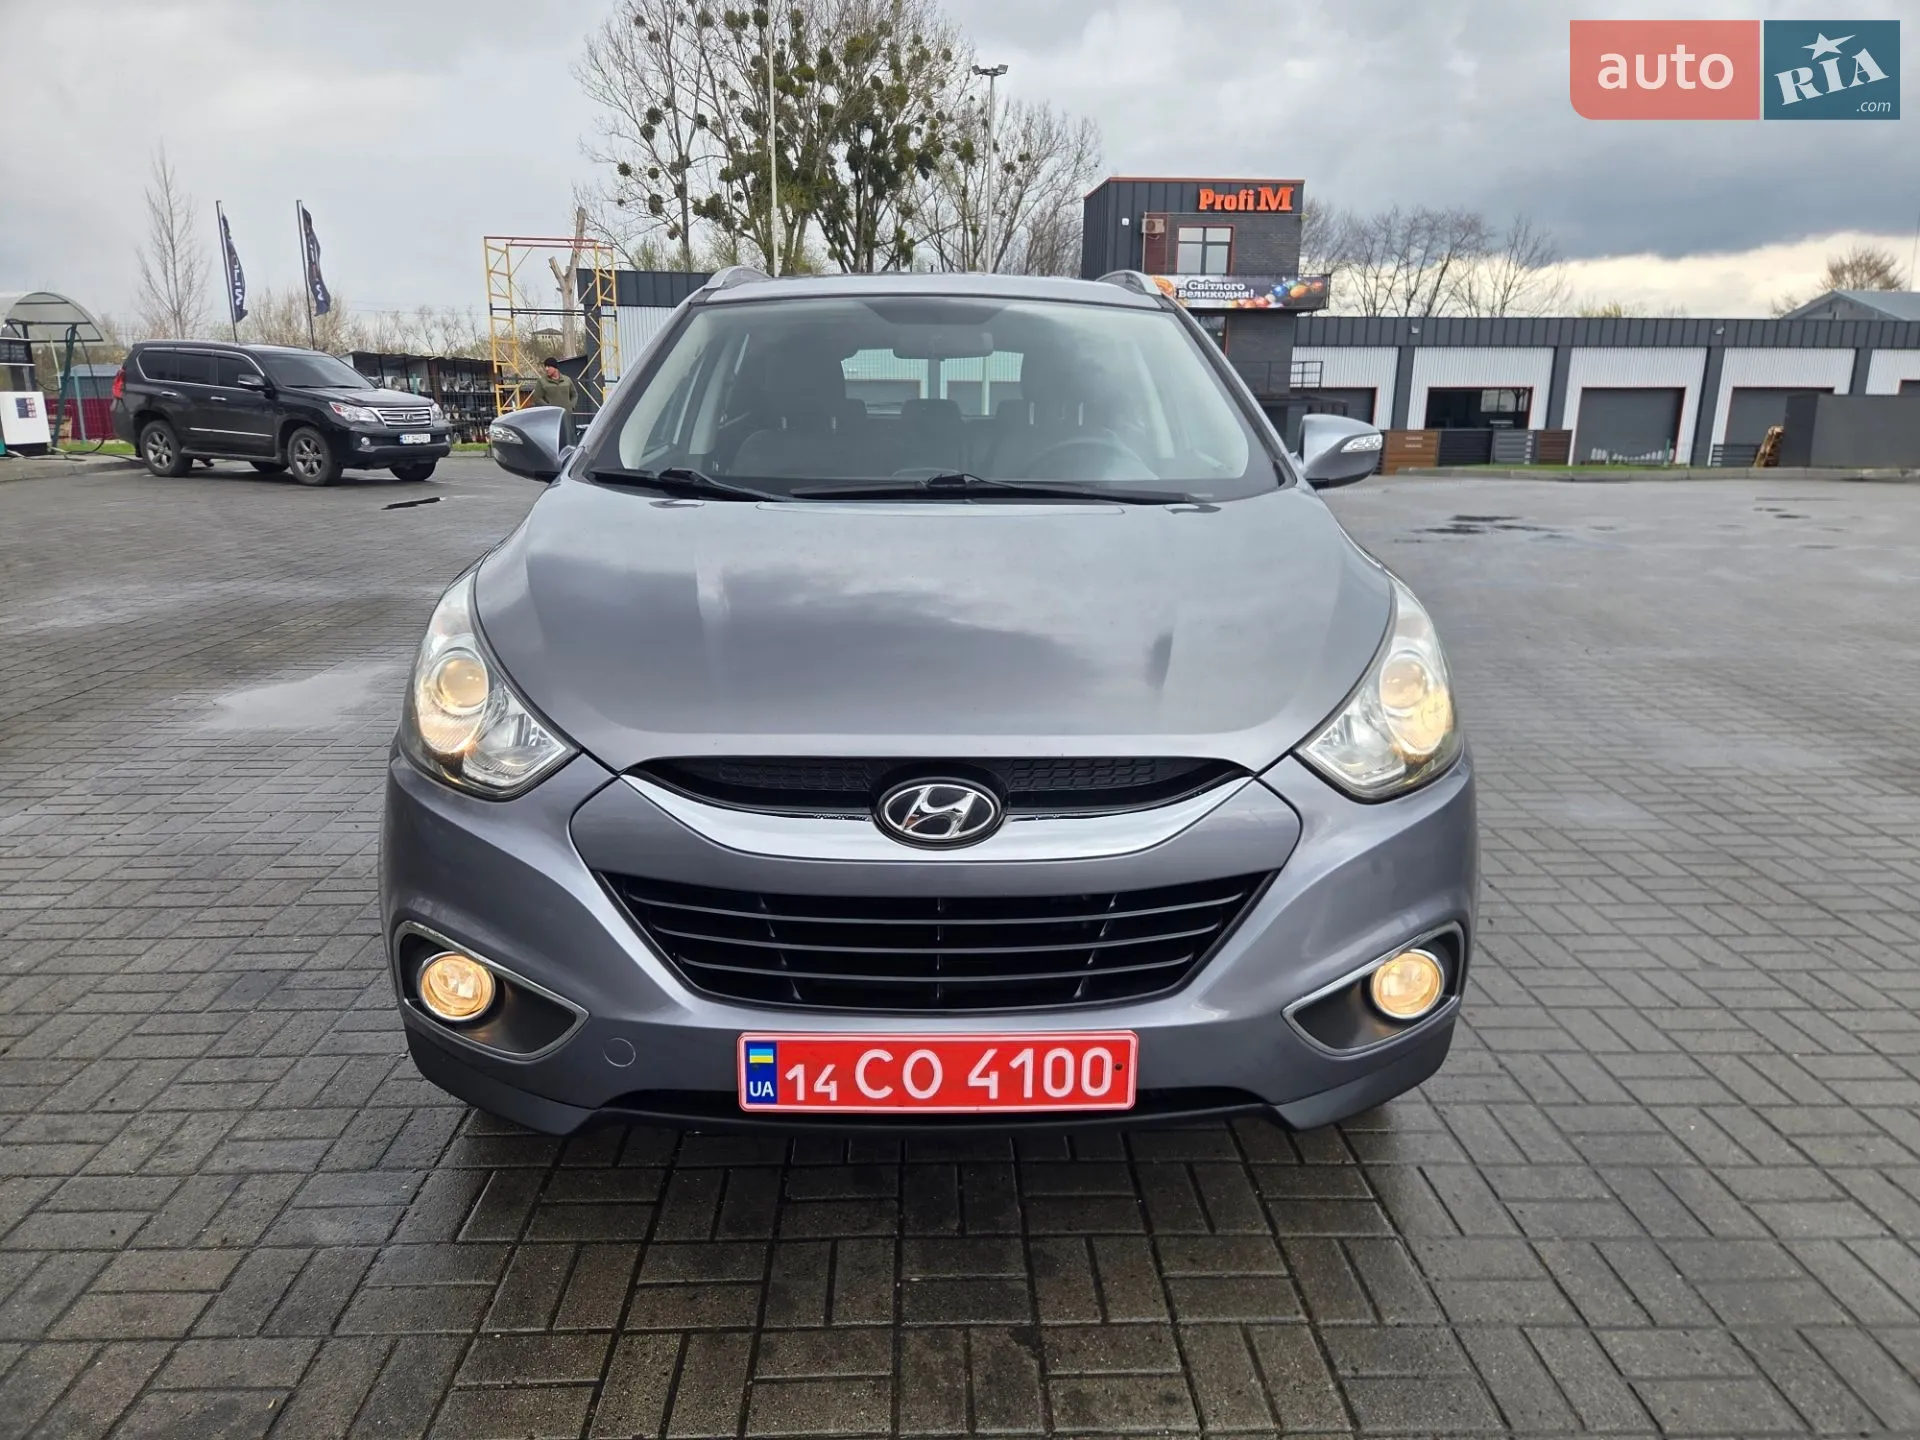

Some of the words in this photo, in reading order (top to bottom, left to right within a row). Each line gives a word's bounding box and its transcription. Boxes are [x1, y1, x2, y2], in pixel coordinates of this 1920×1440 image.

[1188, 281, 1246, 291] Світлого
[784, 1063, 838, 1101] 14
[855, 1049, 943, 1100] CO
[967, 1047, 1113, 1100] 4100
[749, 1081, 774, 1098] UA
